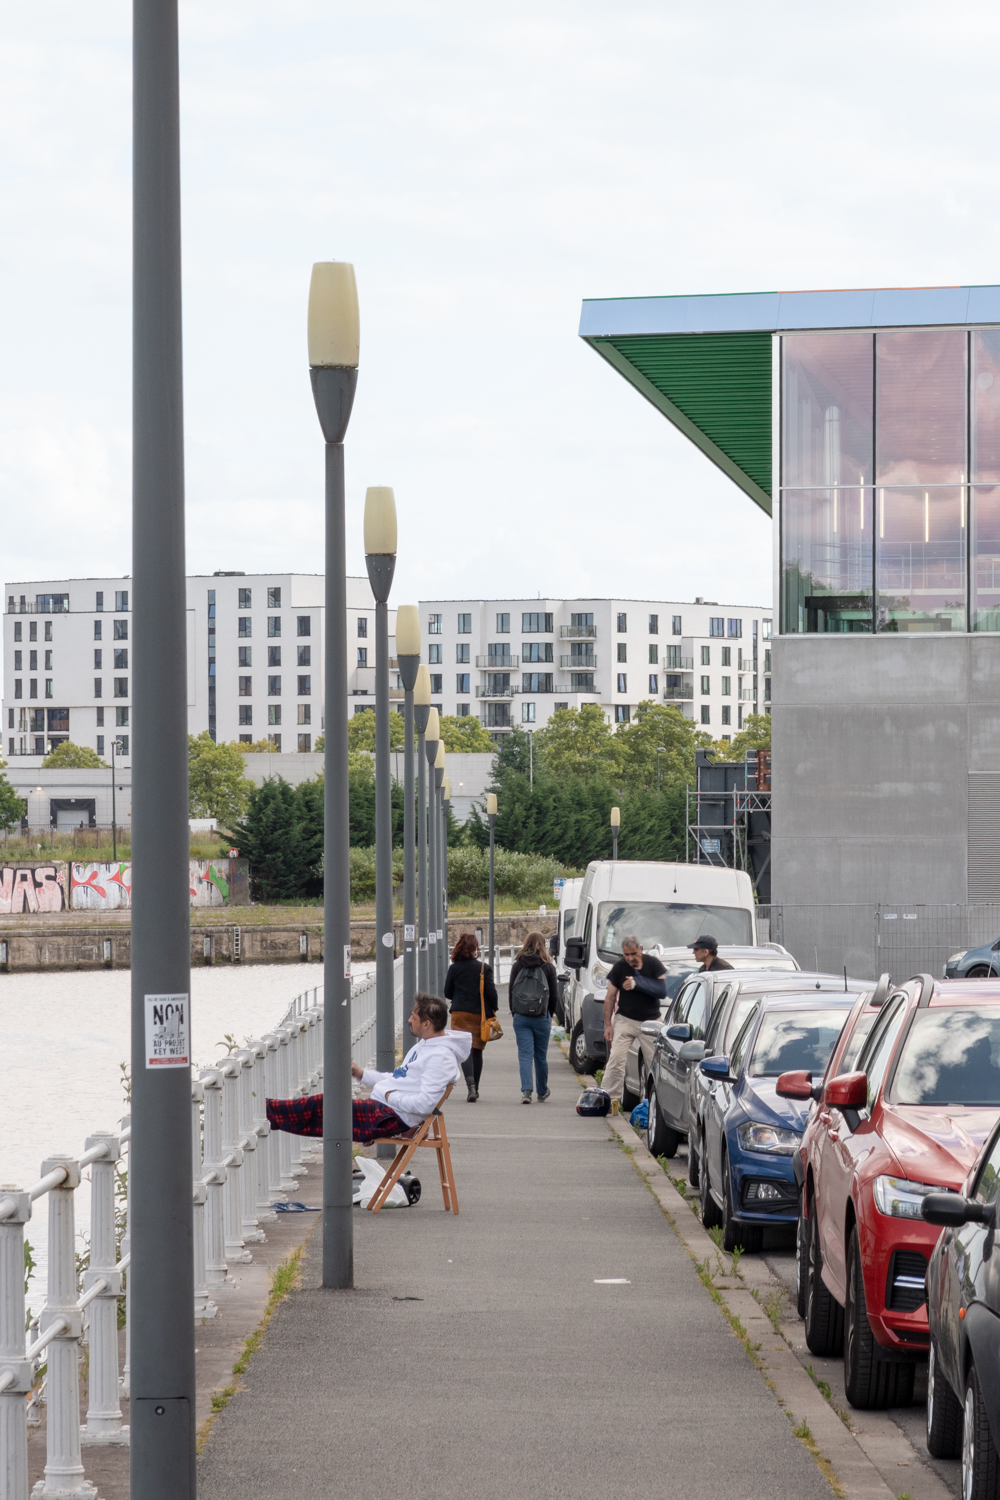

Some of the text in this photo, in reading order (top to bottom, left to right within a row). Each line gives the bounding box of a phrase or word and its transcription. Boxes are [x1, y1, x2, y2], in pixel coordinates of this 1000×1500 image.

[153, 1003, 184, 1025] NON
[165, 1038, 185, 1047] PROJET
[154, 1046, 185, 1055] KEY WEST
